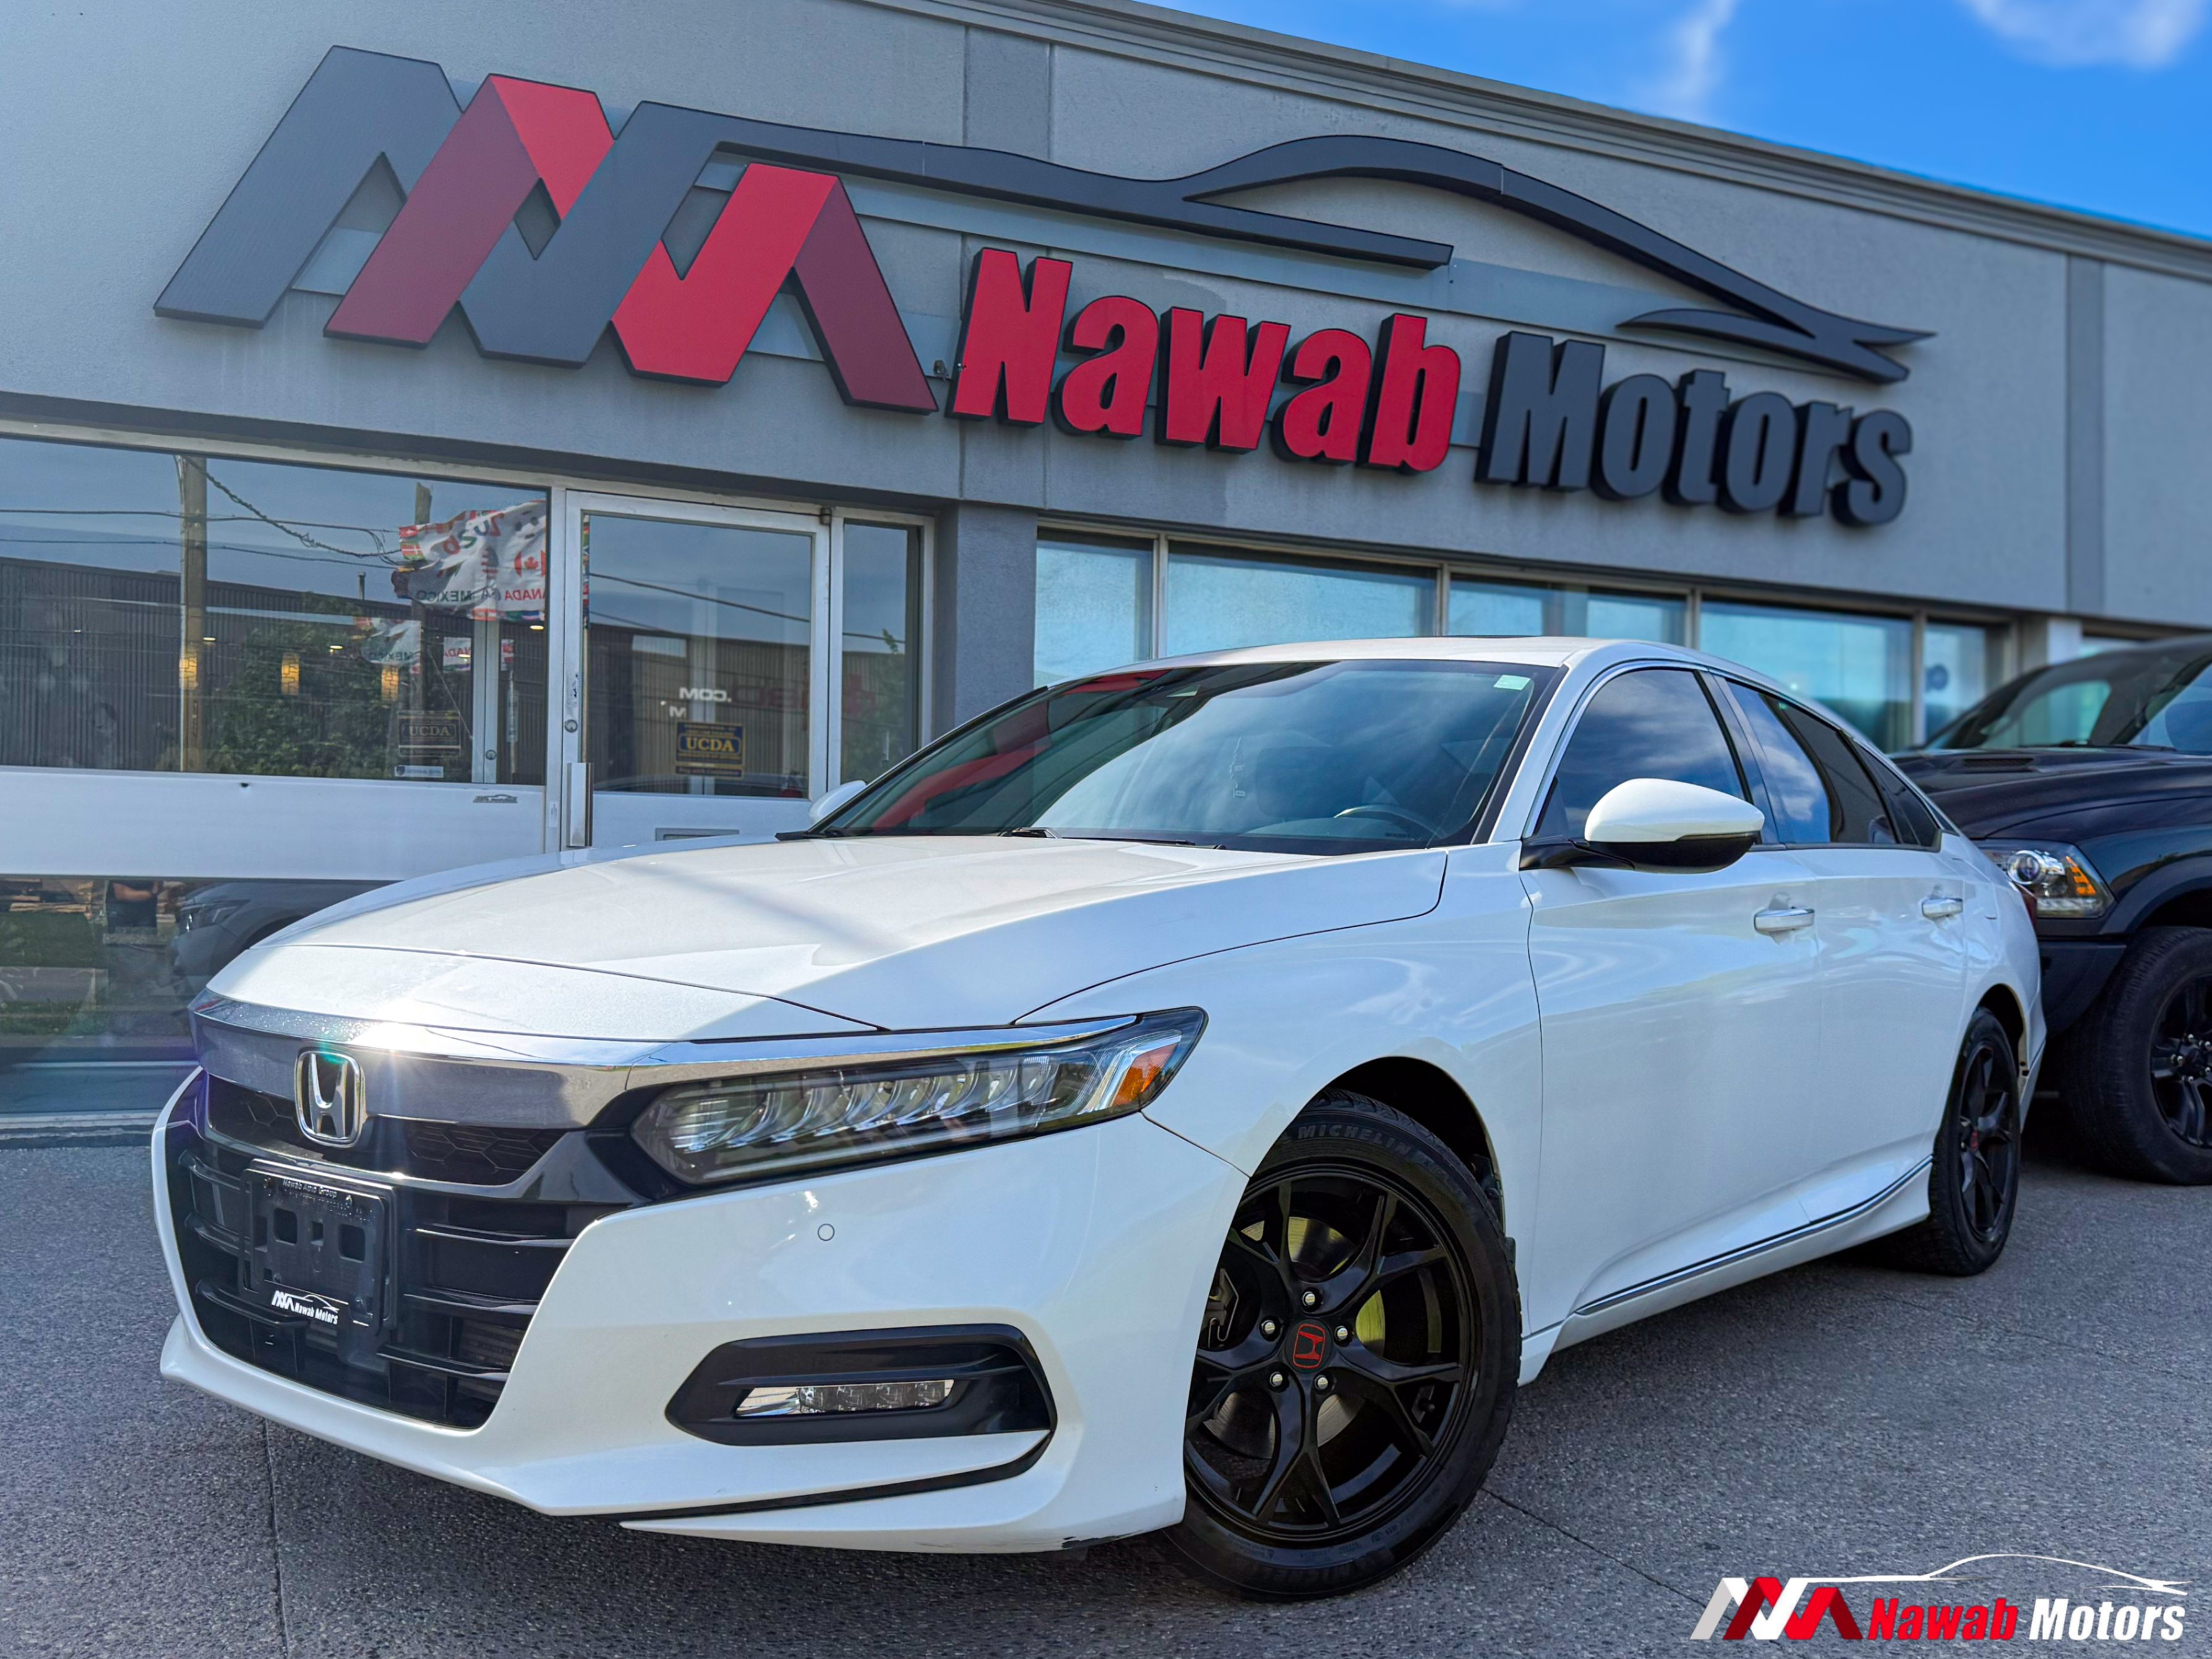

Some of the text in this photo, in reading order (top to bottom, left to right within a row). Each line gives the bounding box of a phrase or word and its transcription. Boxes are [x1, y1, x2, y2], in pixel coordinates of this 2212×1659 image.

[945, 247, 1913, 527] Nawab Motors
[409, 726, 451, 736] UCDA
[686, 737, 734, 752] UCDA
[1298, 1124, 1412, 1156] MICHELIN
[294, 1302, 339, 1325] Nawab Motors
